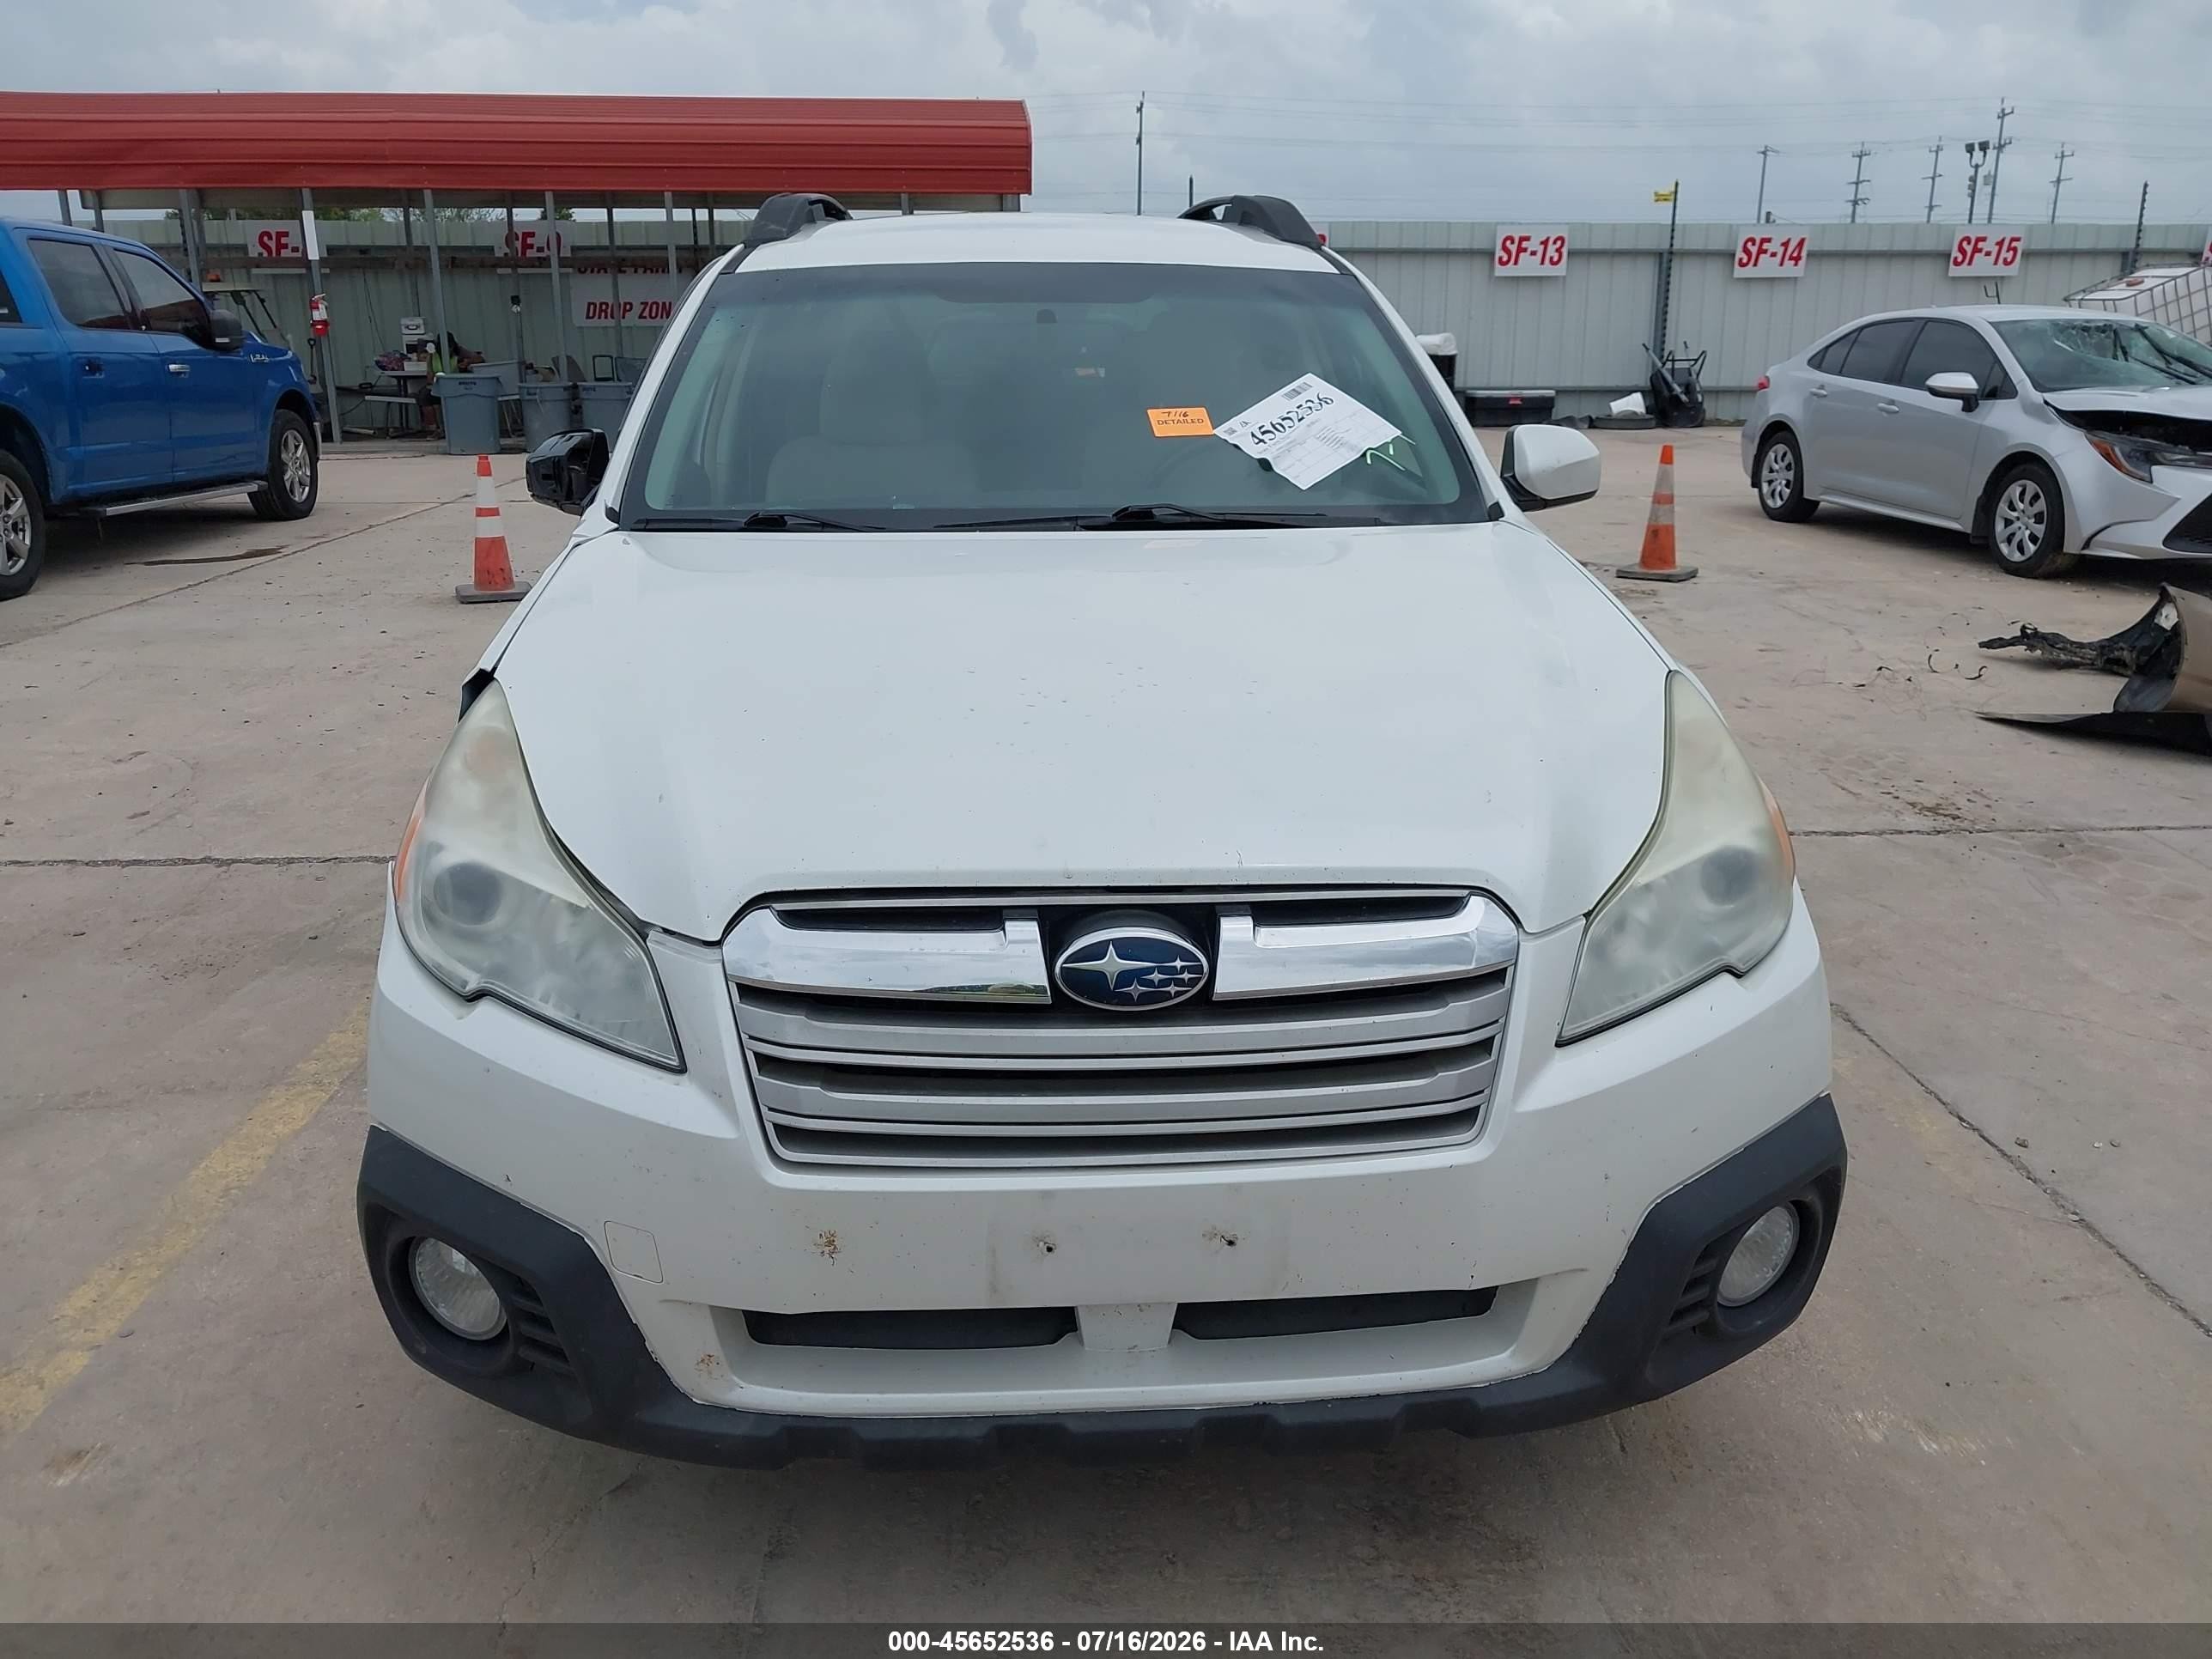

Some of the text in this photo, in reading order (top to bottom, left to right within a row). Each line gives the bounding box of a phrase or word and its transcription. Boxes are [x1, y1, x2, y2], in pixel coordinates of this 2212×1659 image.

[258, 230, 301, 257] SF-
[1498, 234, 1566, 267] SF-13
[1738, 236, 1808, 268] SF-14
[1952, 235, 2022, 267] SF-15
[637, 301, 672, 320] ZON
[1249, 392, 1334, 447] 45652536
